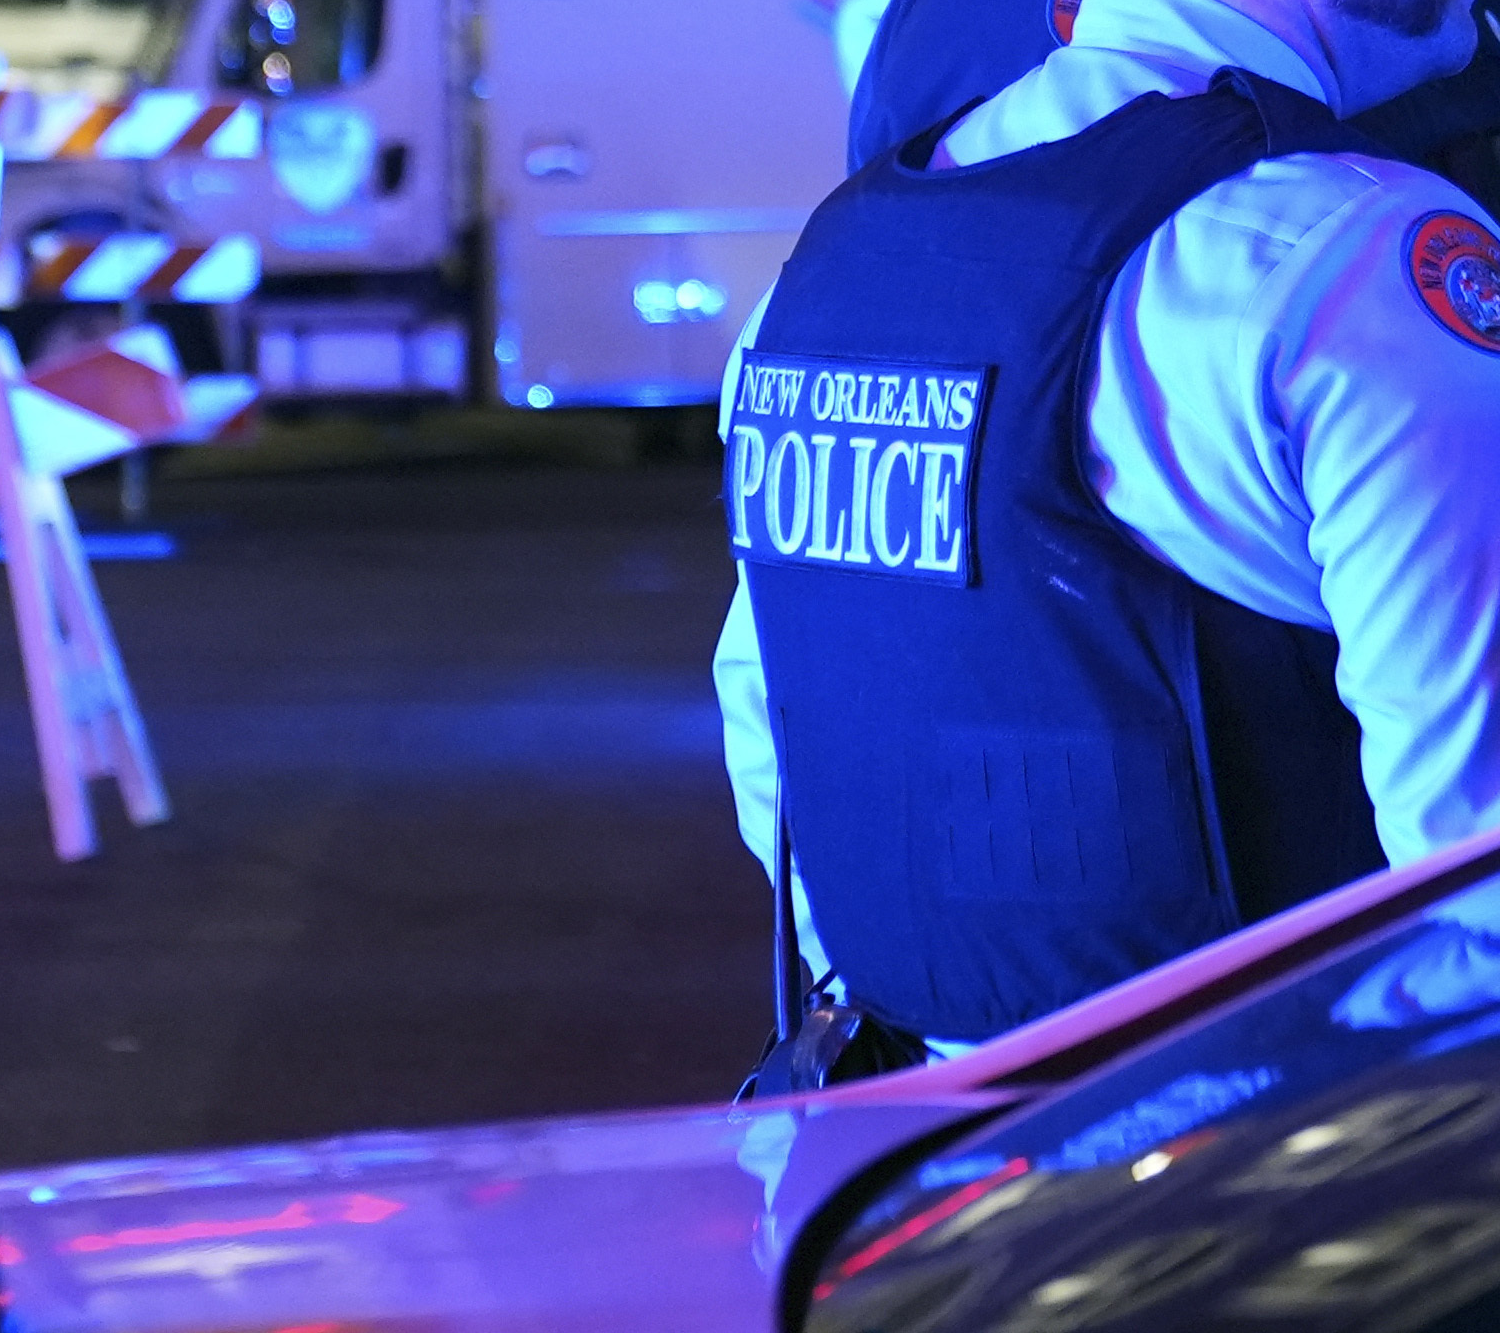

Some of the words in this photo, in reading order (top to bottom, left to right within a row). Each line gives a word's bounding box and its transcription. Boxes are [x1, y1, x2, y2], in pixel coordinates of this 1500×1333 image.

[737, 364, 805, 417] NEW
[810, 370, 977, 431] ORLEANS
[733, 424, 964, 573] POLICE
